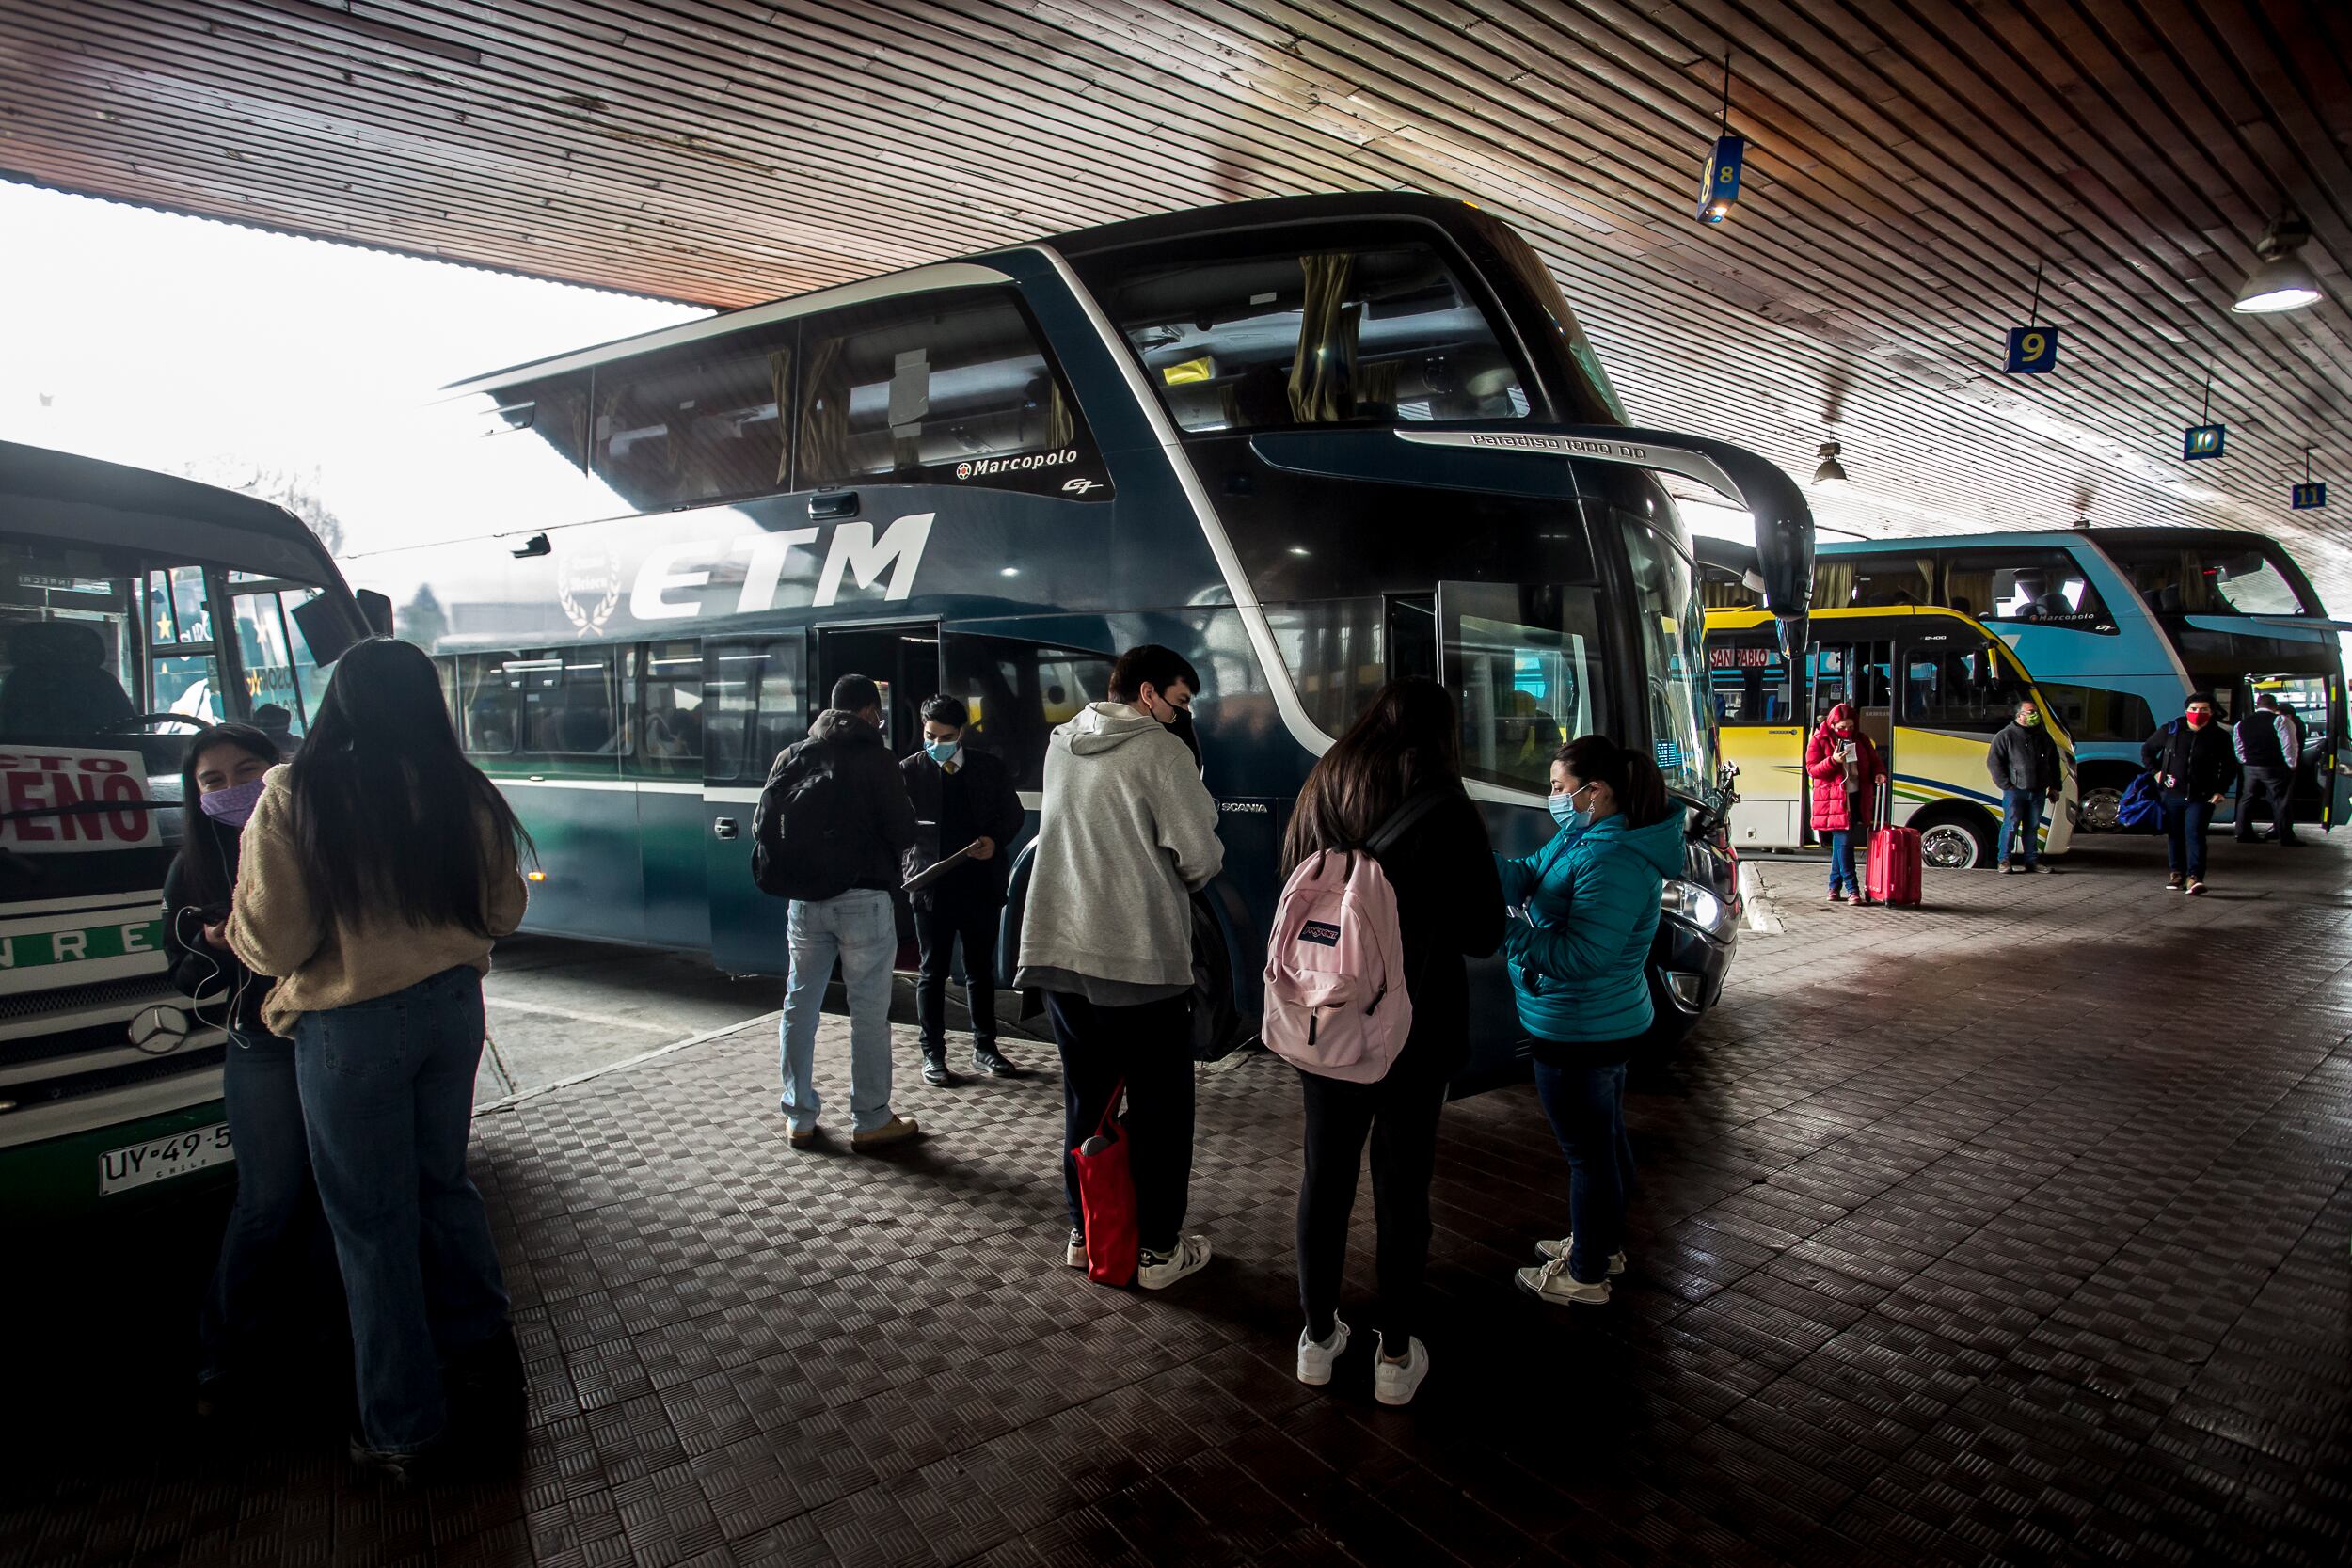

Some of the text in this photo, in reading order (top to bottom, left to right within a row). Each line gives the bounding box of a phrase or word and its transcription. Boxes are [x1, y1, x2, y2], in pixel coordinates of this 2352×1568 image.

[1701, 157, 1712, 203] 8
[1720, 166, 1733, 183] 8
[2022, 333, 2045, 362] 9
[1470, 435, 1559, 449] Paradiso
[2190, 429, 2218, 453] 10
[973, 450, 1077, 476] Marcopolo
[1062, 478, 1104, 494] G7
[2298, 487, 2319, 505] 11
[629, 513, 936, 620] ETM
[2040, 613, 2094, 622] Marcopolo
[1710, 648, 1768, 666] SAN PABLO
[0, 771, 149, 843] ENO
[1221, 802, 1268, 813] SCANIA
[155, 1159, 207, 1178] CHILE
